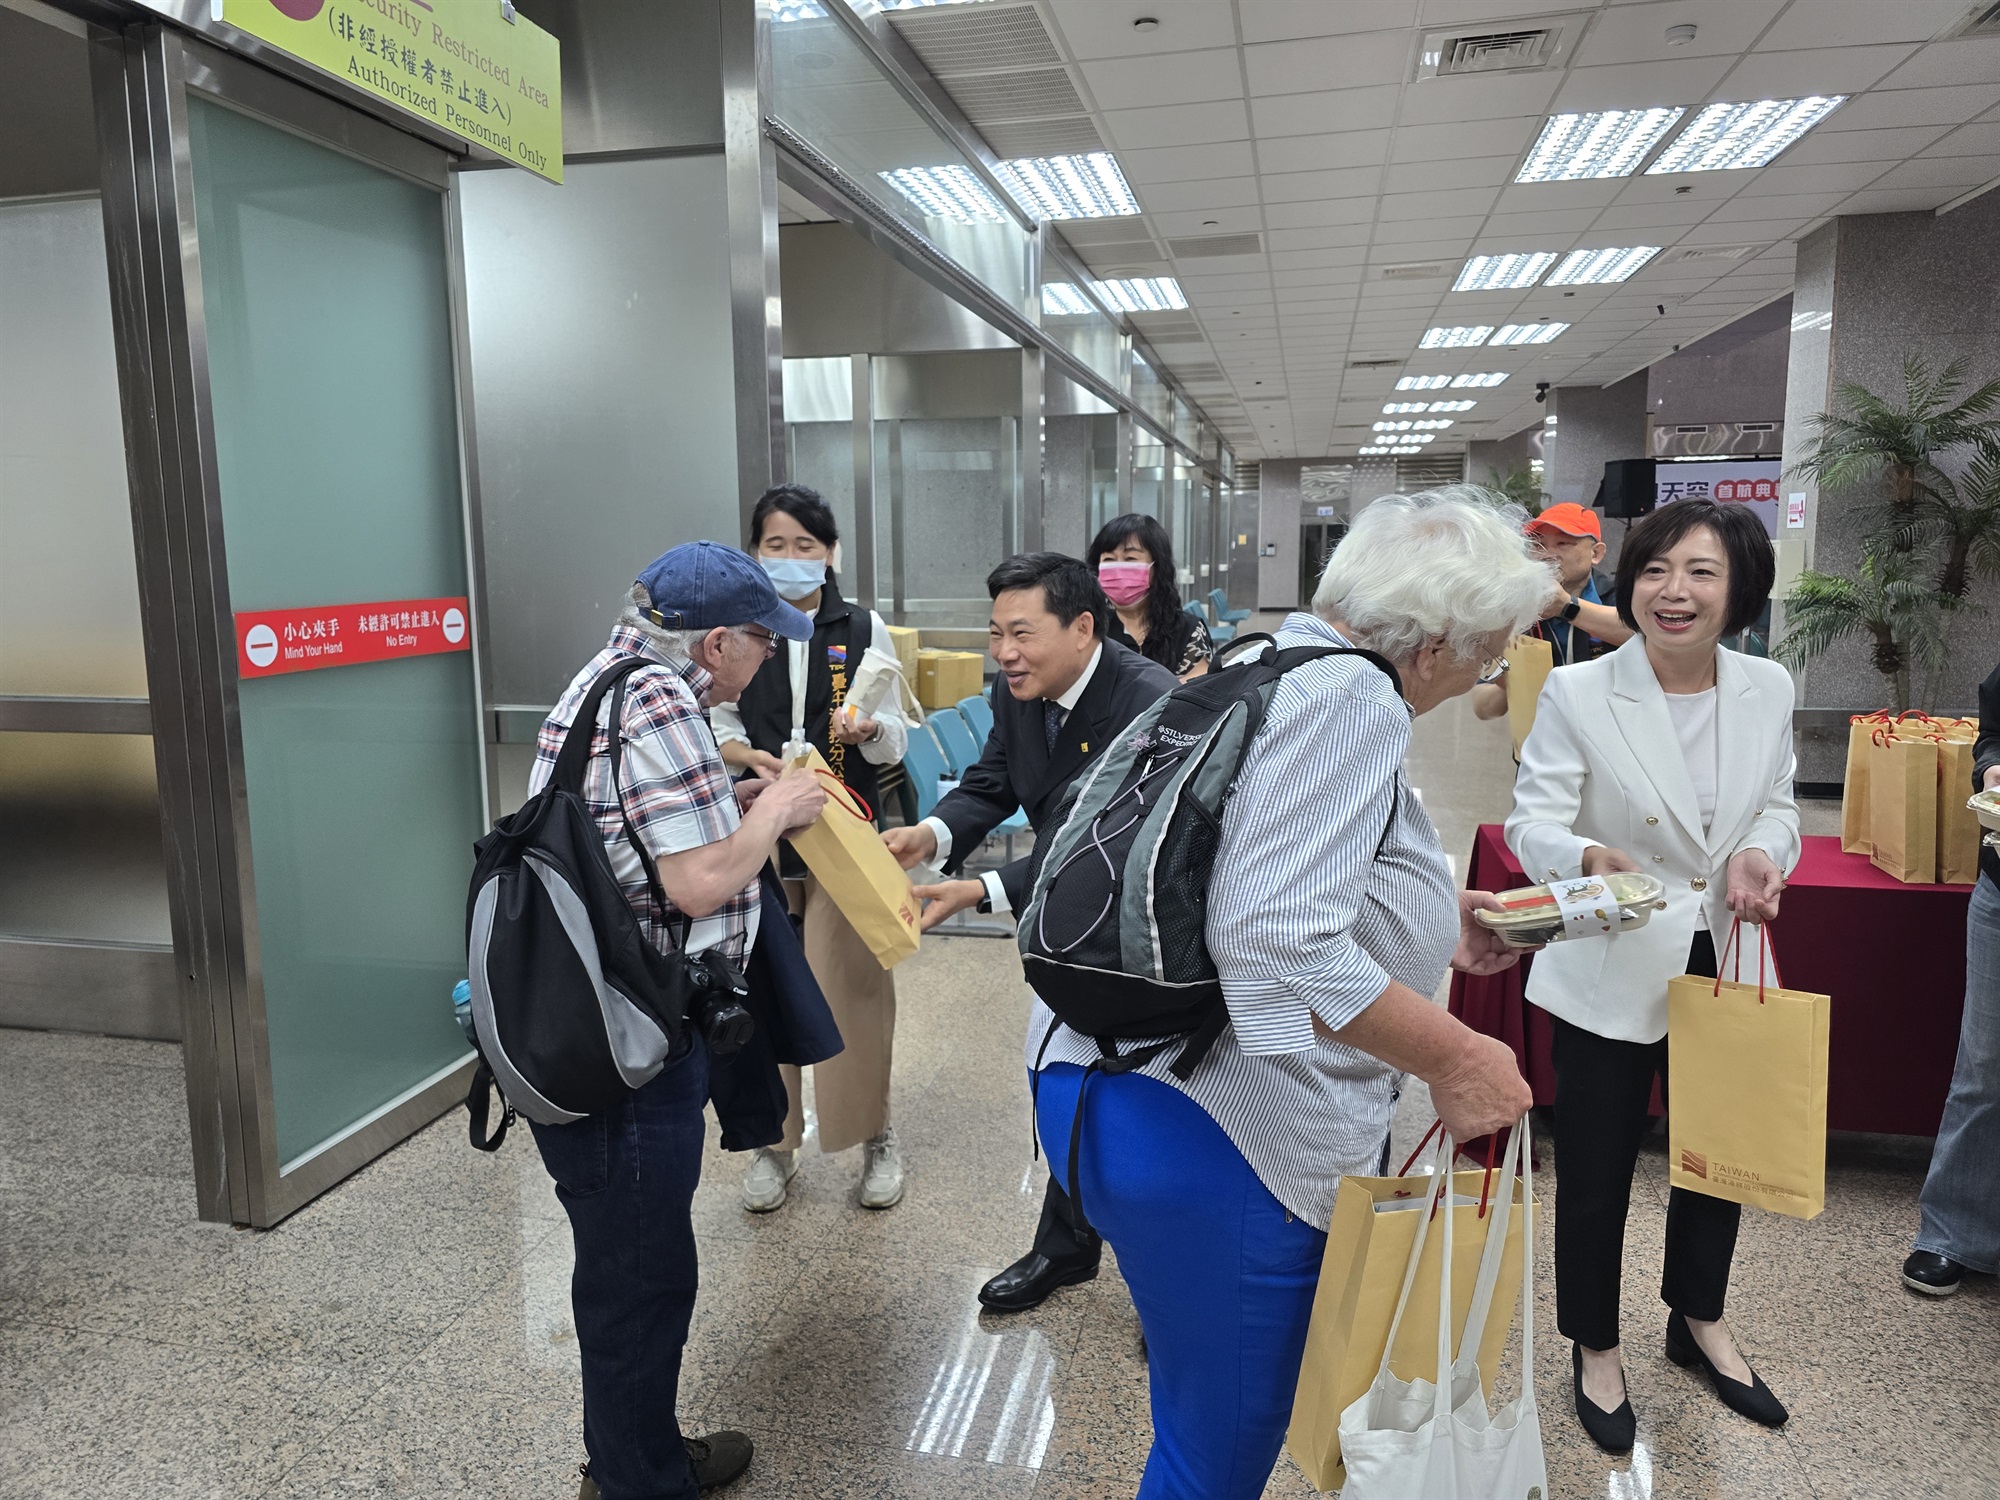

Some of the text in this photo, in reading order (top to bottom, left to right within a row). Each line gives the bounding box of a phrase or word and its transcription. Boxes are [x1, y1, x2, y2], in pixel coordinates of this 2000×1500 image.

[328, 6, 512, 126] (非經授權者禁止進入)
[432, 22, 511, 87] Restricted
[518, 76, 550, 109] Area
[347, 55, 548, 171] Authorized Personnel Only
[1655, 481, 1709, 503] 天空
[284, 618, 340, 642] 小心夾手
[357, 611, 440, 633] 未經許可禁止進入
[284, 641, 343, 659] Mind Your Hand
[386, 634, 417, 647] No Entry
[1712, 1162, 1760, 1182] TAIWAN
